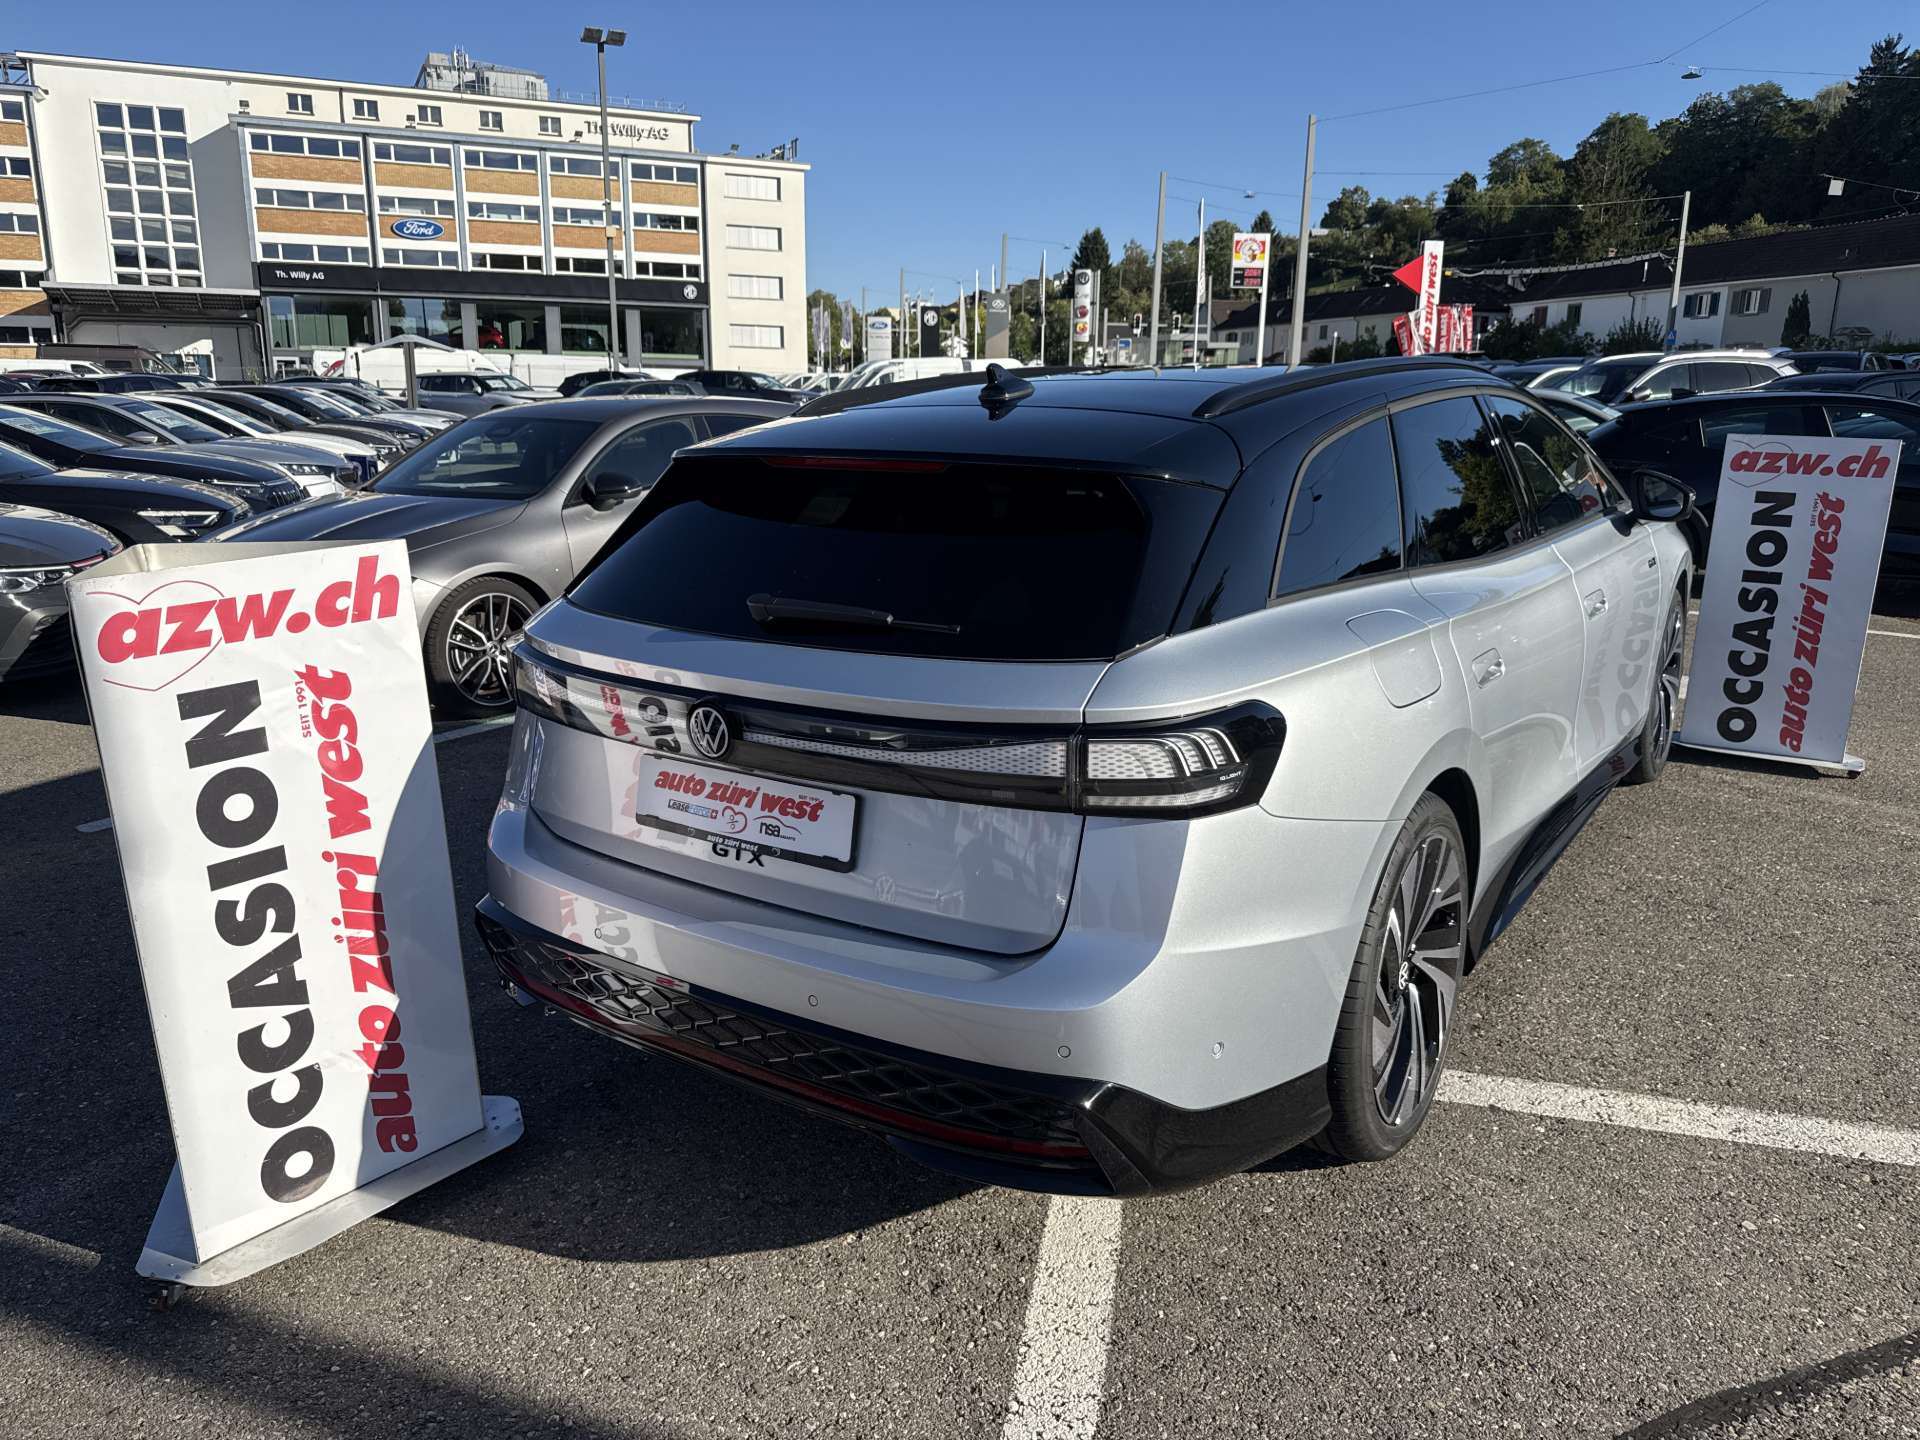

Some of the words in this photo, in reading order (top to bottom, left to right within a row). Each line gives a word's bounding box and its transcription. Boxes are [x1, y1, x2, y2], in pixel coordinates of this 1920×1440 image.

[611, 123, 644, 141] Willy
[646, 127, 669, 140] AG
[403, 221, 434, 236] Ford
[275, 270, 288, 279] Th.
[289, 271, 311, 281] Willy
[312, 272, 325, 280] AG
[1428, 252, 1438, 289] west
[1730, 445, 1891, 478] azw.ch
[1809, 492, 1846, 581] west
[97, 555, 400, 663] azw.ch
[1717, 491, 1797, 743] OCCASION
[1793, 582, 1828, 669] züri
[296, 679, 307, 710] 1991
[1780, 667, 1813, 752] auto
[302, 713, 312, 738] SEIT
[294, 664, 372, 839] west
[654, 770, 706, 796] auto
[707, 781, 760, 808] züri
[761, 792, 824, 822] west
[707, 835, 723, 843] auto
[741, 843, 758, 852] west
[760, 821, 780, 838] nsa
[712, 843, 764, 867] GTX
[176, 680, 335, 1203] OCCASION
[322, 851, 398, 996] züri
[354, 1004, 418, 1153] auto
